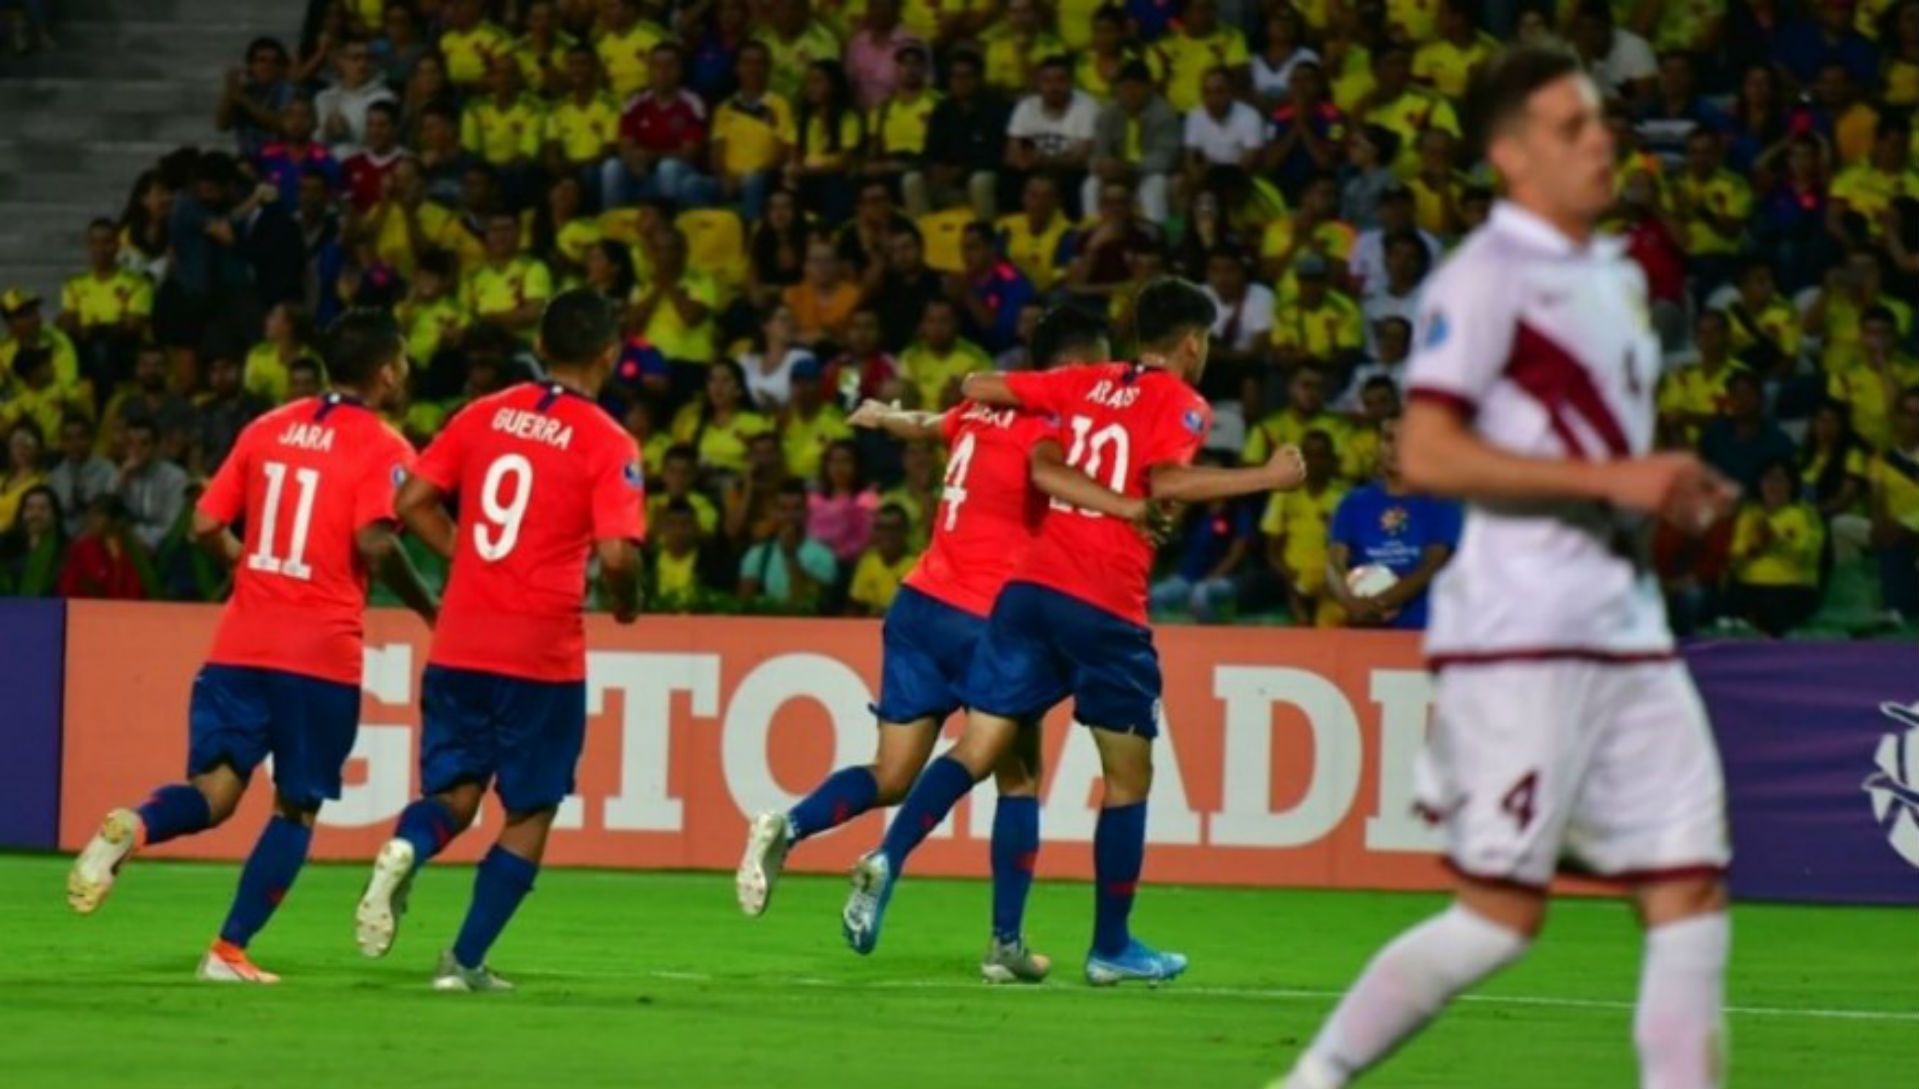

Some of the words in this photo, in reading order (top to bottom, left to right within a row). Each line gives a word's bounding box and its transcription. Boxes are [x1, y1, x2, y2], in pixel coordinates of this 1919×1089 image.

[278, 423, 335, 452] JARA
[491, 407, 573, 450] GUERRA
[1049, 414, 1130, 517] 10
[247, 460, 321, 580] 11
[472, 452, 533, 562] 9
[942, 431, 976, 532] 4
[264, 643, 1446, 850] GTOADE
[1500, 770, 1539, 832] 4
